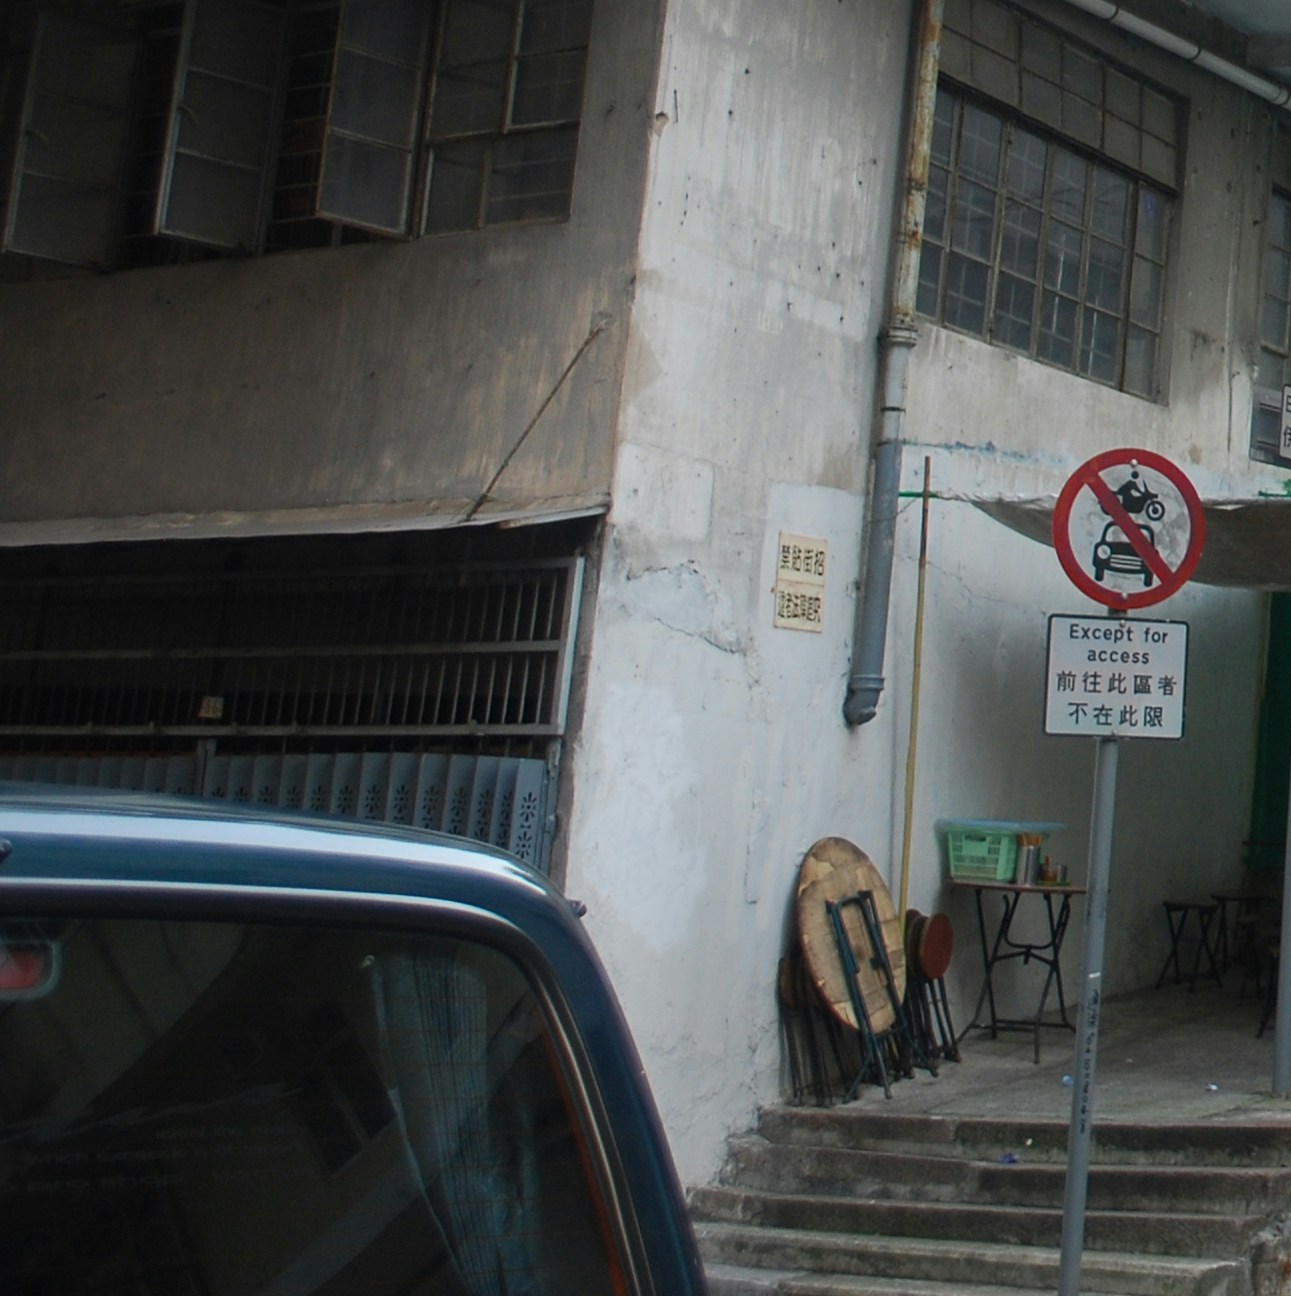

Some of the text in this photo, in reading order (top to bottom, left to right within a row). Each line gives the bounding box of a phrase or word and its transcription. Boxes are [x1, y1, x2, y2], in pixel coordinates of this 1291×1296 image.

[1069, 623, 1168, 644] Except for
[1087, 649, 1150, 664] access
[1056, 670, 1177, 696] 前往此區者
[1067, 702, 1163, 728] 不在此限
